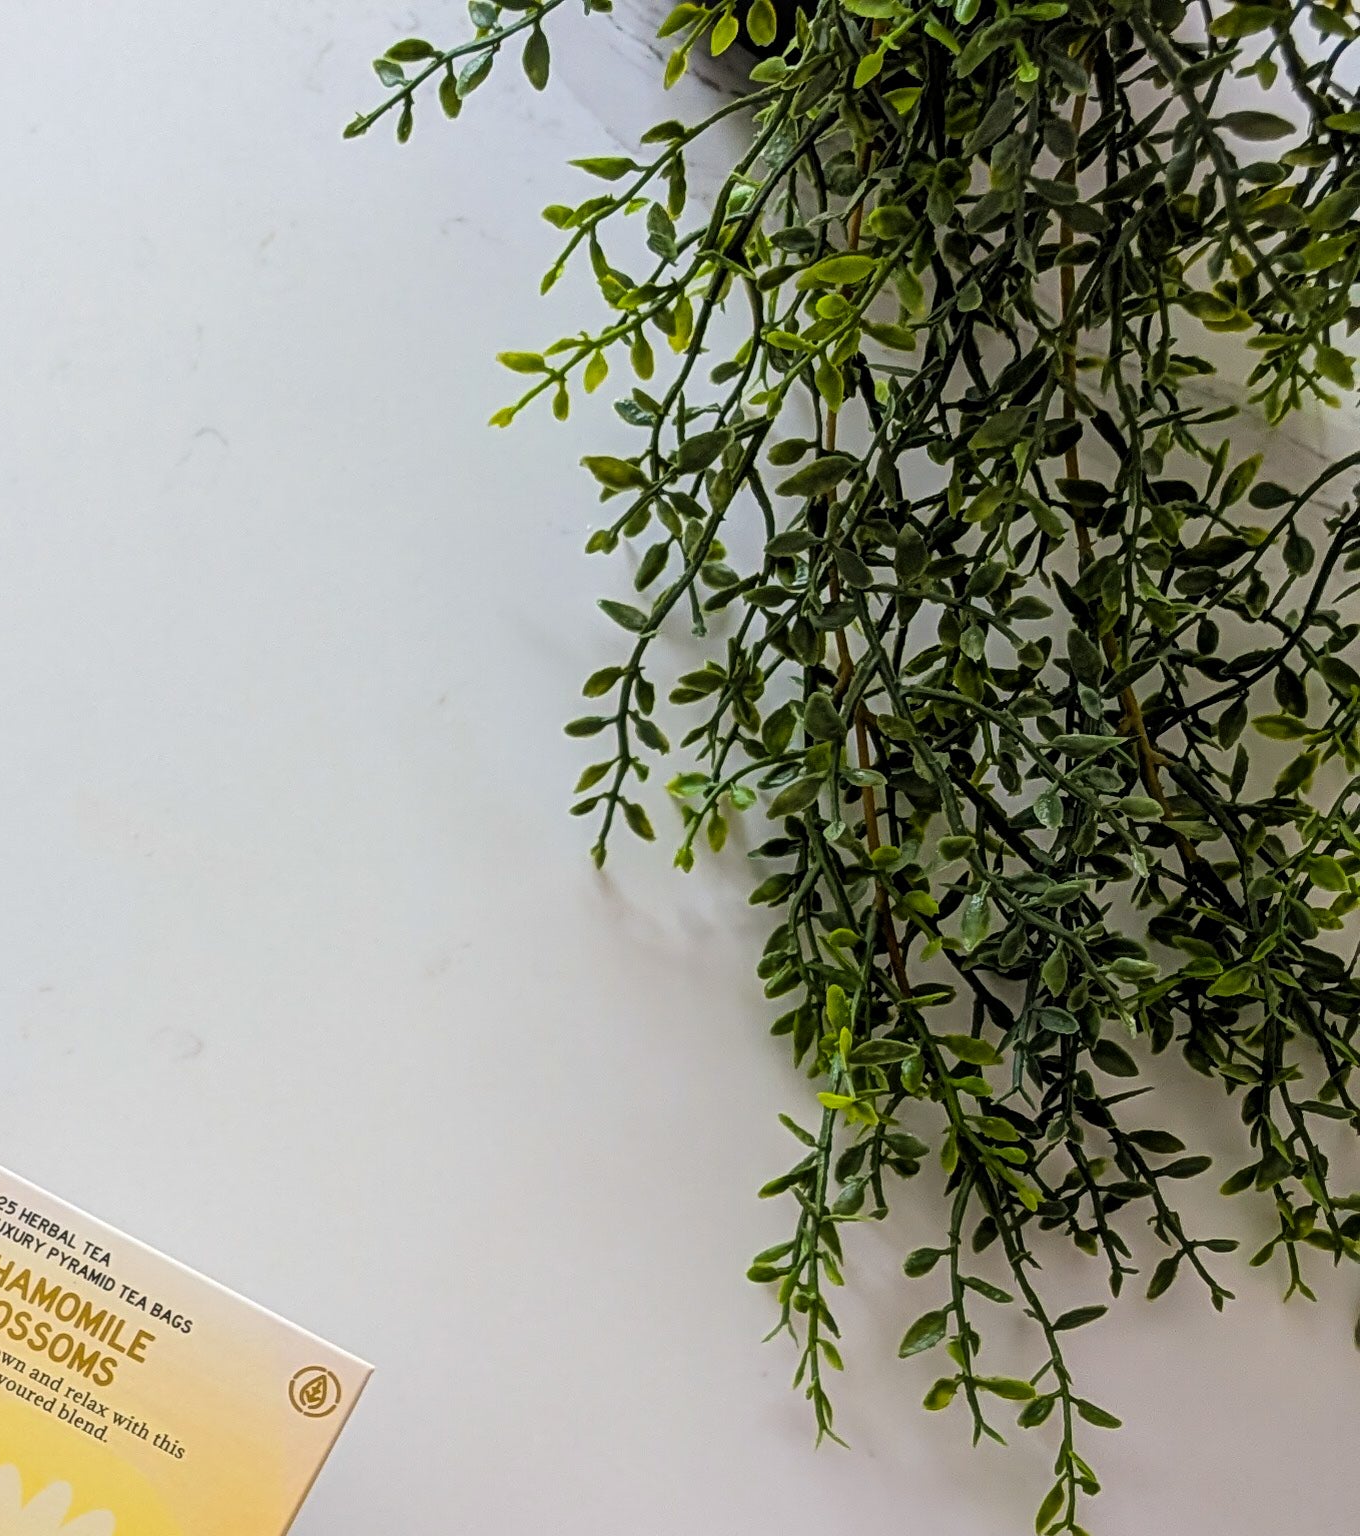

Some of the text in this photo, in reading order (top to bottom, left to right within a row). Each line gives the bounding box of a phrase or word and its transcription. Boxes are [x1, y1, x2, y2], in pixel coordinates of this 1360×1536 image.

[18, 1207, 77, 1249] HERBAL
[80, 1240, 112, 1267] TEA
[46, 1246, 116, 1292] PYRAMID
[118, 1284, 148, 1311] TEA
[149, 1302, 194, 1334] BAGS
[29, 1368, 65, 1393] and
[64, 1386, 110, 1418] relax
[112, 1411, 150, 1440] with
[152, 1432, 186, 1460] this
[57, 1403, 109, 1443] blend.
